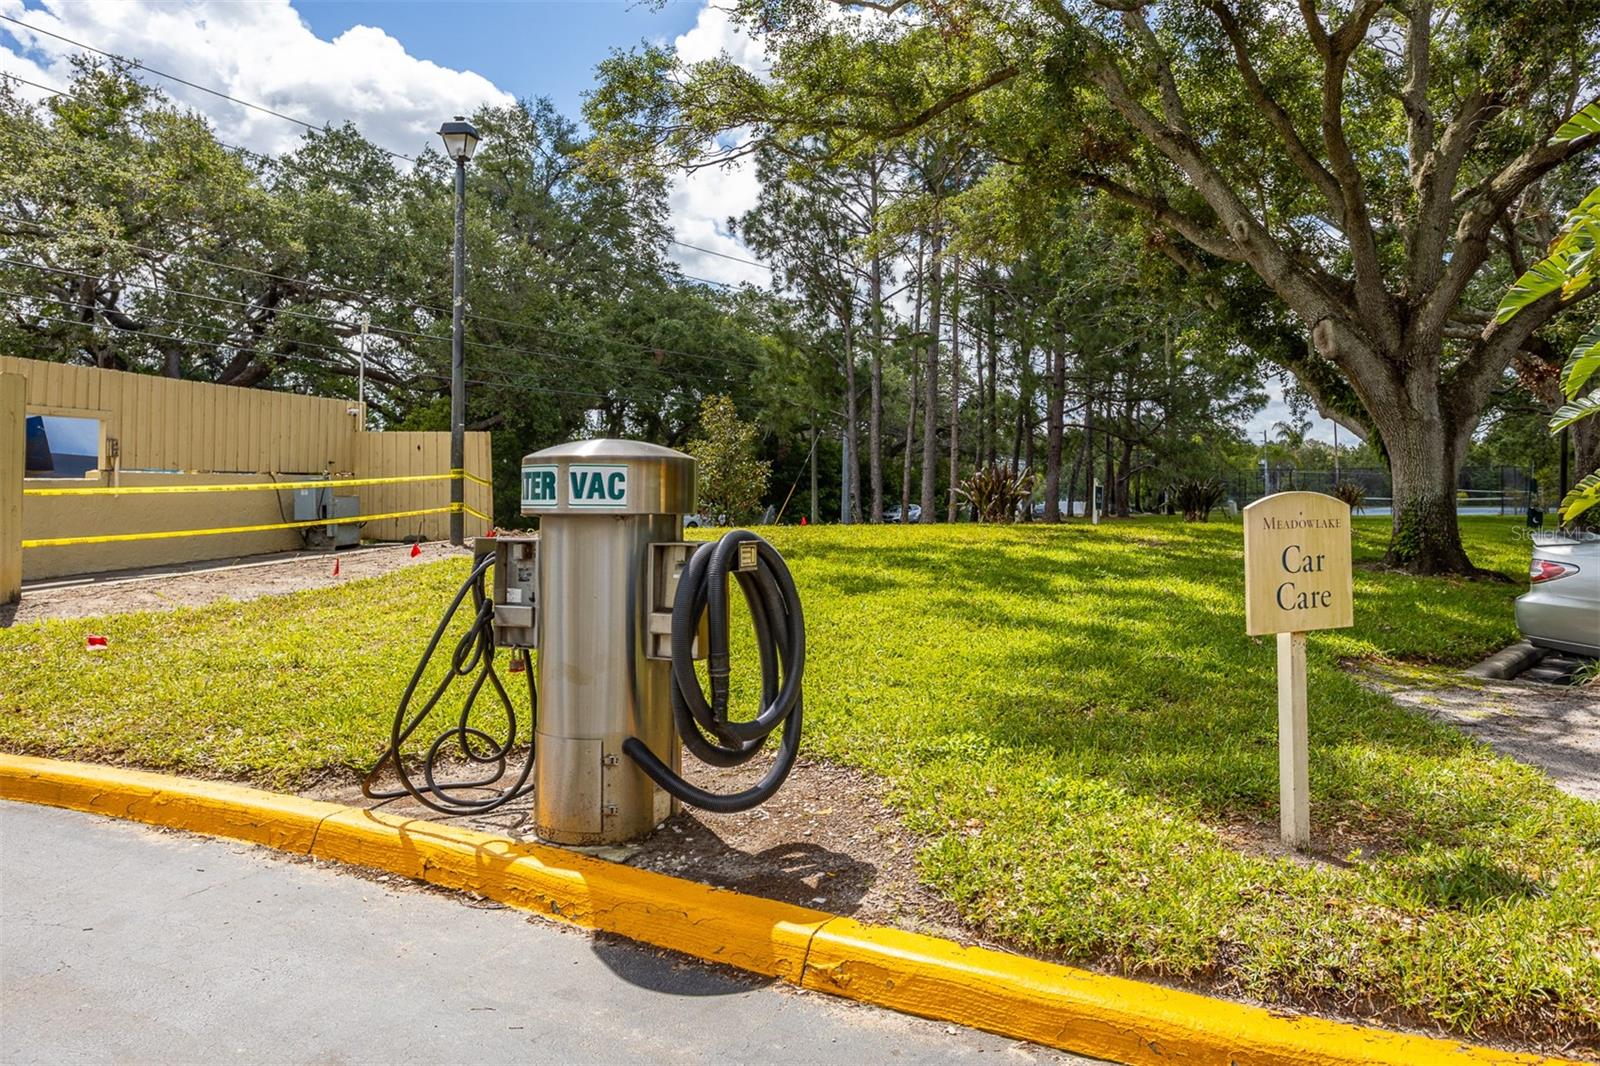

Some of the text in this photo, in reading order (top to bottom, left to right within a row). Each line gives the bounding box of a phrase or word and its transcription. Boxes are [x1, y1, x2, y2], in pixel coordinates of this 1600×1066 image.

[570, 472, 626, 500] VAC
[1263, 517, 1341, 530] MEADOWLAKE
[1281, 545, 1325, 574] Car
[1276, 582, 1332, 611] Care
